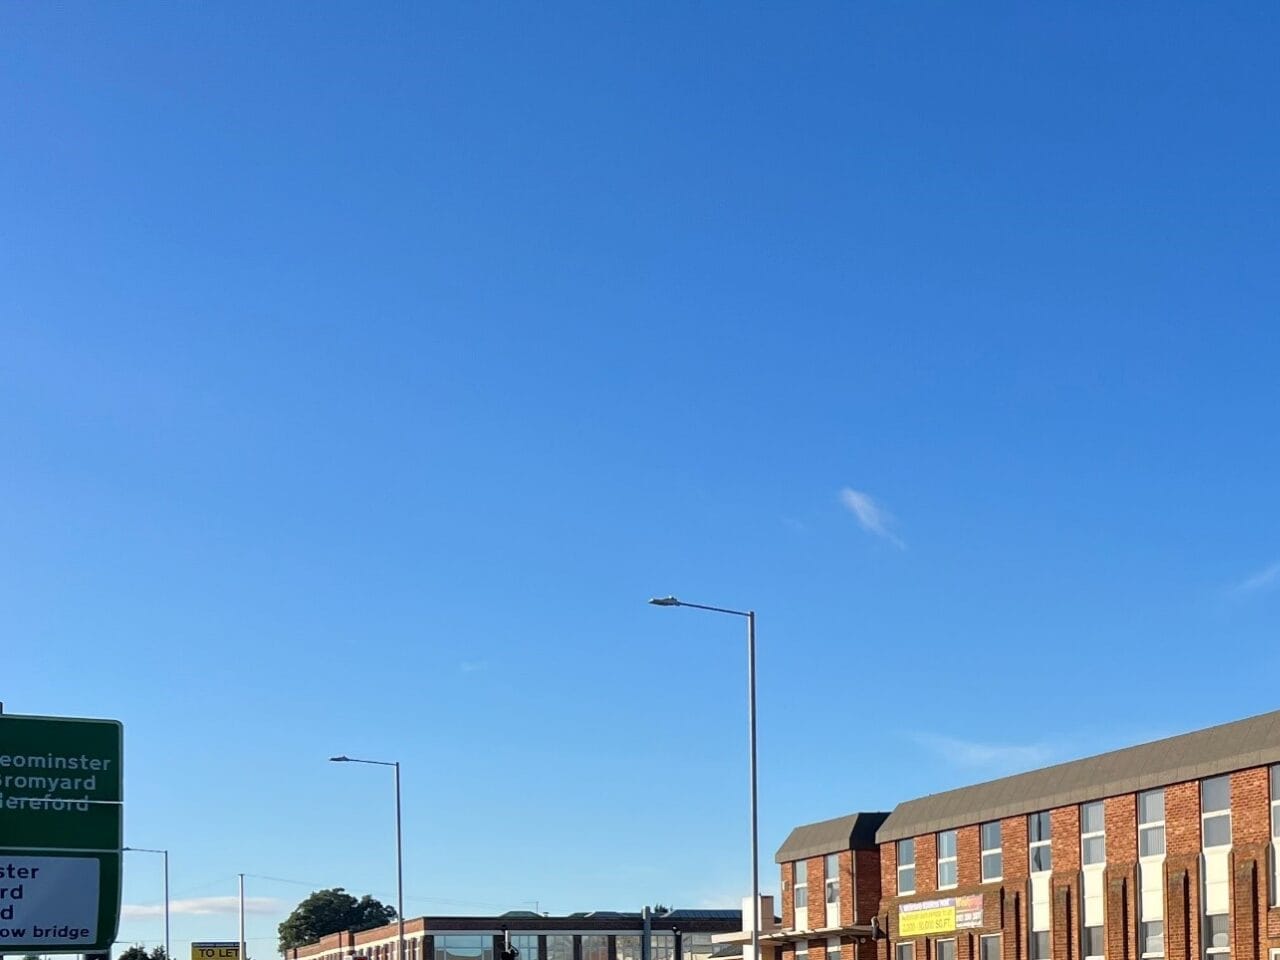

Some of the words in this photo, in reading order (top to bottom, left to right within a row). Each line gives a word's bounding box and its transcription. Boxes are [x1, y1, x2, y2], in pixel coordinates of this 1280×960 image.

[0, 774, 97, 793] romyard
[33, 925, 90, 940] bridge
[199, 949, 215, 958] TO
[219, 949, 239, 958] LET
